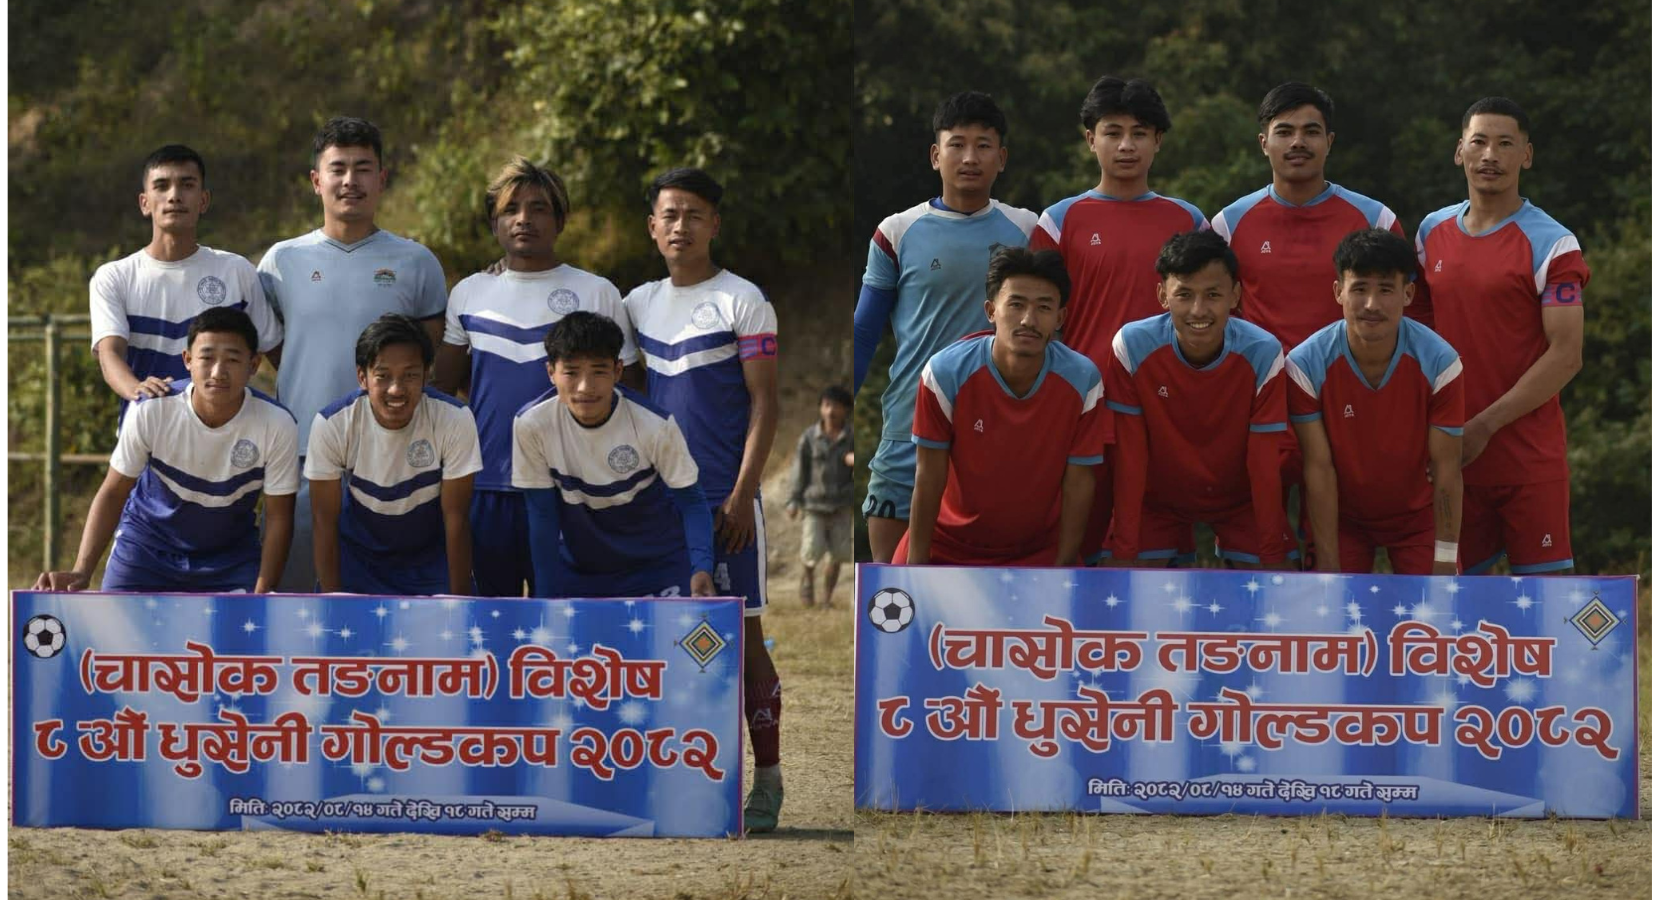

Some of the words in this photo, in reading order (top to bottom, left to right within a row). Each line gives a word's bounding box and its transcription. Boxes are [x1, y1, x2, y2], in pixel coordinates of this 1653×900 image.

[1555, 282, 1576, 304] C
[762, 336, 776, 356] C
[928, 615, 1148, 681] (चासोक
[1156, 629, 1378, 678] तङनाम)
[1388, 620, 1557, 689] विशेष
[79, 641, 283, 703] (चासोक
[291, 653, 499, 699] तङनाम)
[508, 643, 667, 710] विशेष
[33, 718, 68, 761] ८
[157, 708, 313, 779] धुसेनी
[320, 708, 562, 771] गोल्डकप
[569, 727, 726, 782] २०८२
[877, 695, 914, 739] ८
[1011, 686, 1178, 759] धुसेनी
[1187, 685, 1445, 751] गोल्डकप
[1453, 704, 1622, 761] २०८२
[271, 801, 374, 819] २०८२/०८/१४
[375, 800, 403, 818] गते
[405, 800, 441, 821] देखि
[445, 805, 464, 819] १८
[467, 800, 496, 819] गते
[1134, 781, 1244, 800] २०८२/०८/१४
[1246, 780, 1275, 799] गते
[1278, 780, 1317, 802] देखि
[1319, 785, 1342, 800] १८
[1345, 781, 1374, 800] गते
